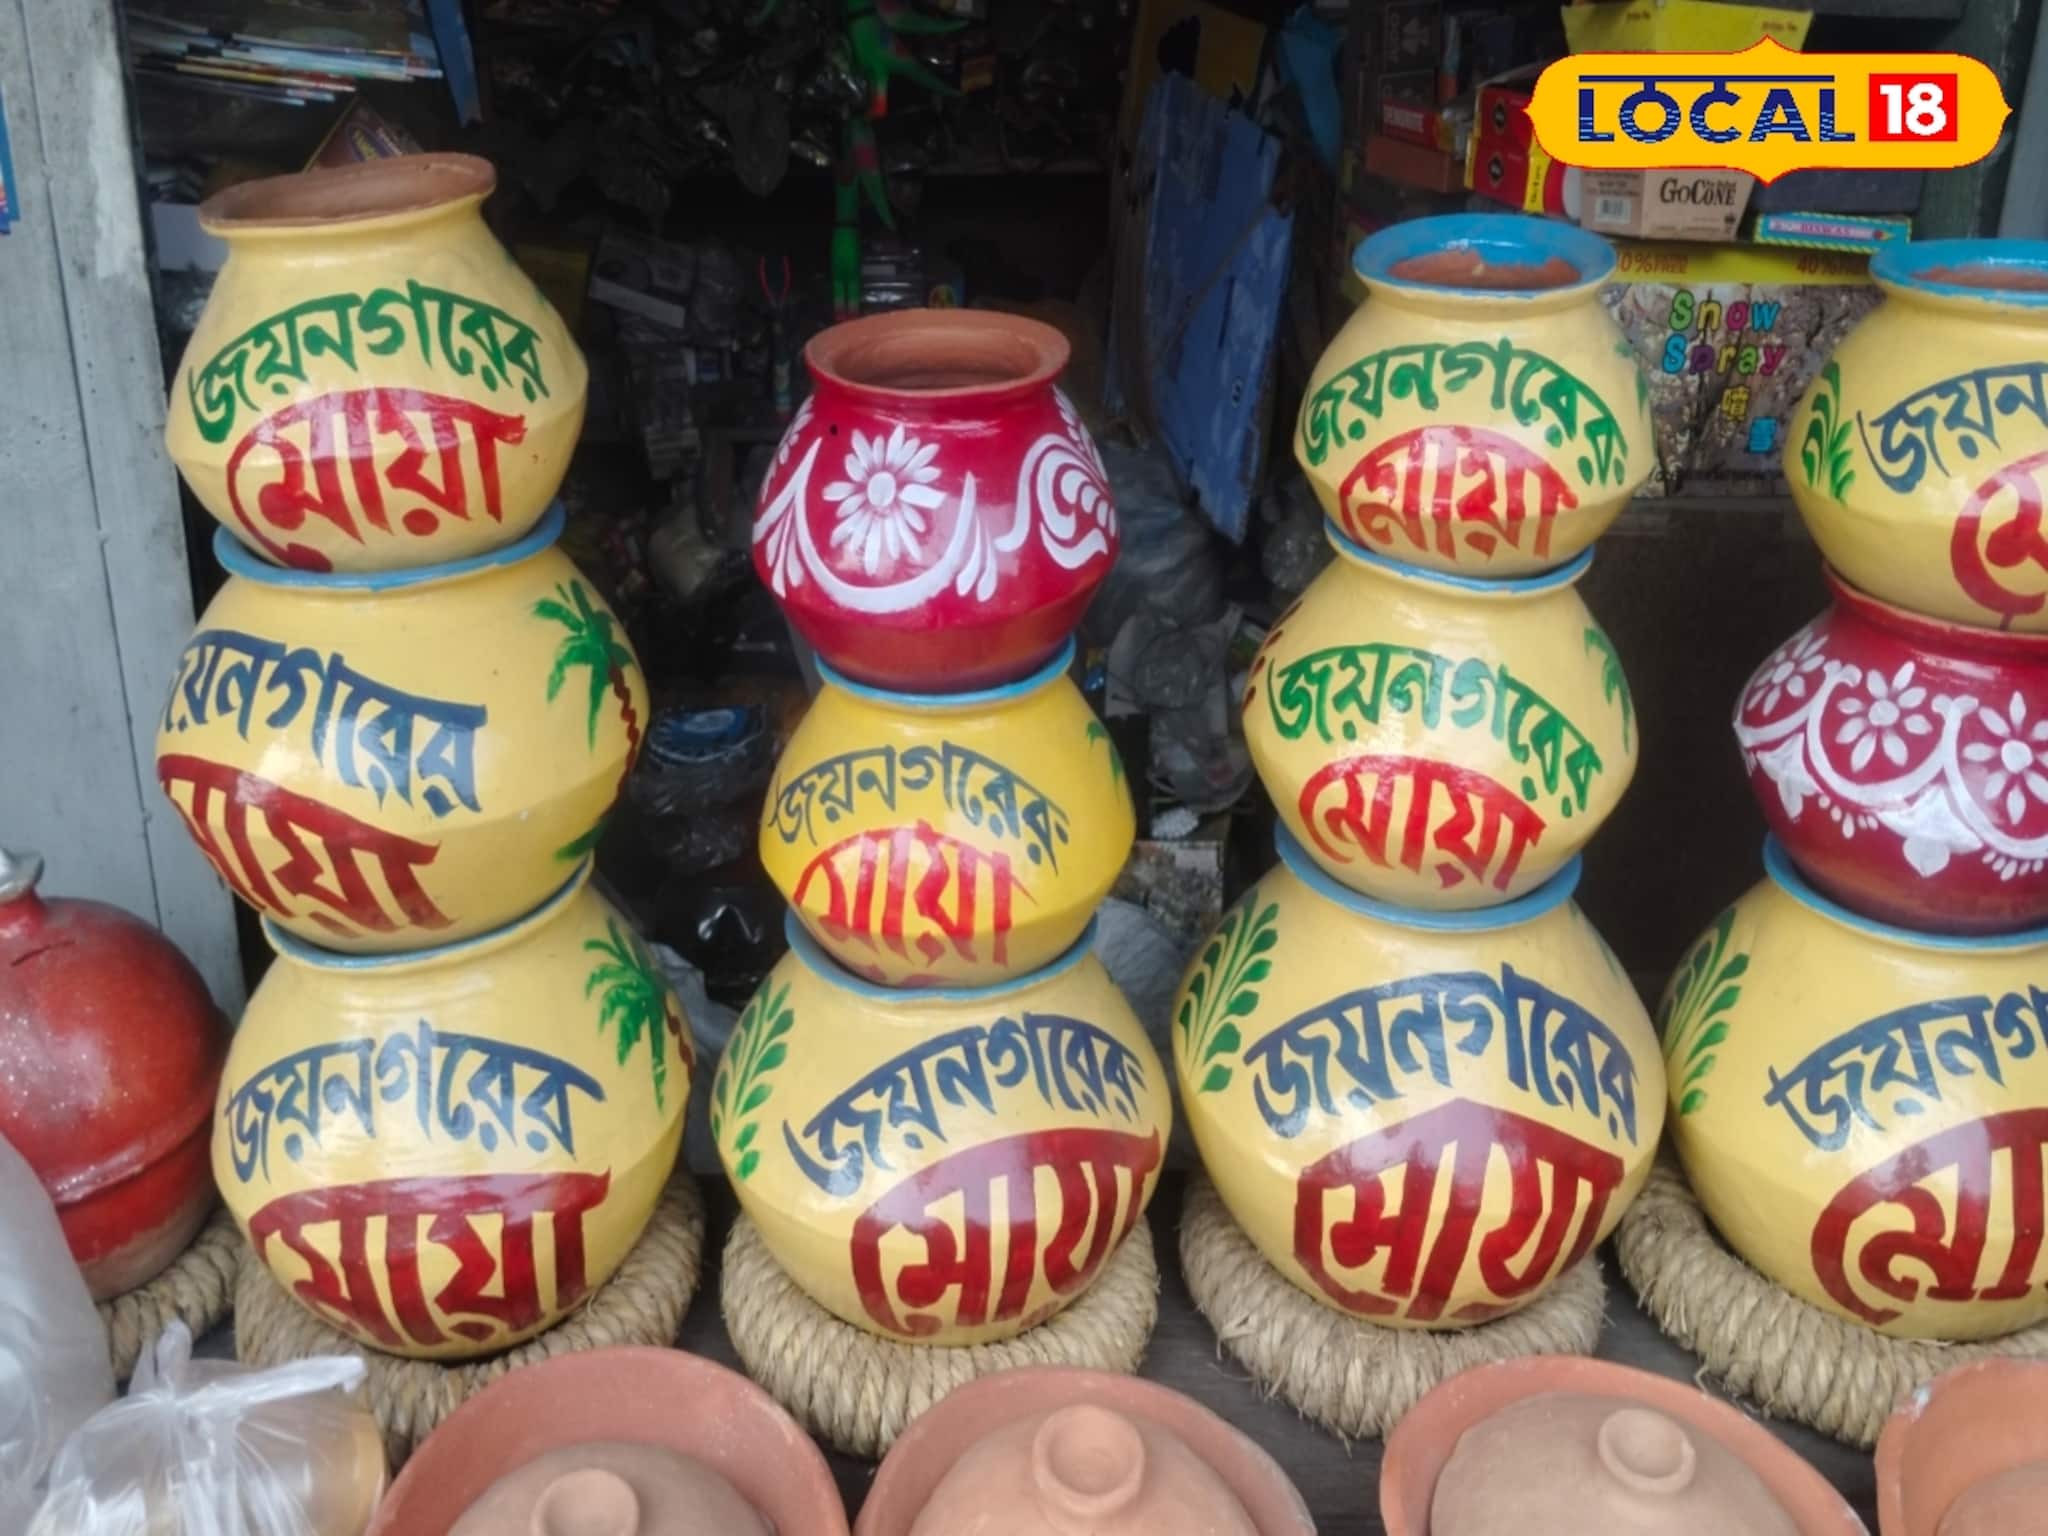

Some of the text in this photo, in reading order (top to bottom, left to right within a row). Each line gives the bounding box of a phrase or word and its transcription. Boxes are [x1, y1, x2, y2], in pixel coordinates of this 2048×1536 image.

[1620, 252, 1653, 274] 0%
[1668, 289, 1781, 332] Snow
[189, 279, 549, 443] জয়নগরের
[1301, 336, 1628, 487] জয়নগরের
[1662, 333, 1787, 376] Spray
[227, 387, 528, 573] মোয়া
[1339, 425, 1578, 560] মোয়া
[1268, 642, 1602, 818] জয়নগরের
[768, 741, 1070, 877] জয়নগরের
[1299, 755, 1546, 892] মোয়া
[224, 1018, 606, 1183] জয়নগরের
[782, 1011, 1147, 1197] জয়নগরের
[1244, 962, 1638, 1147] জয়নগরের
